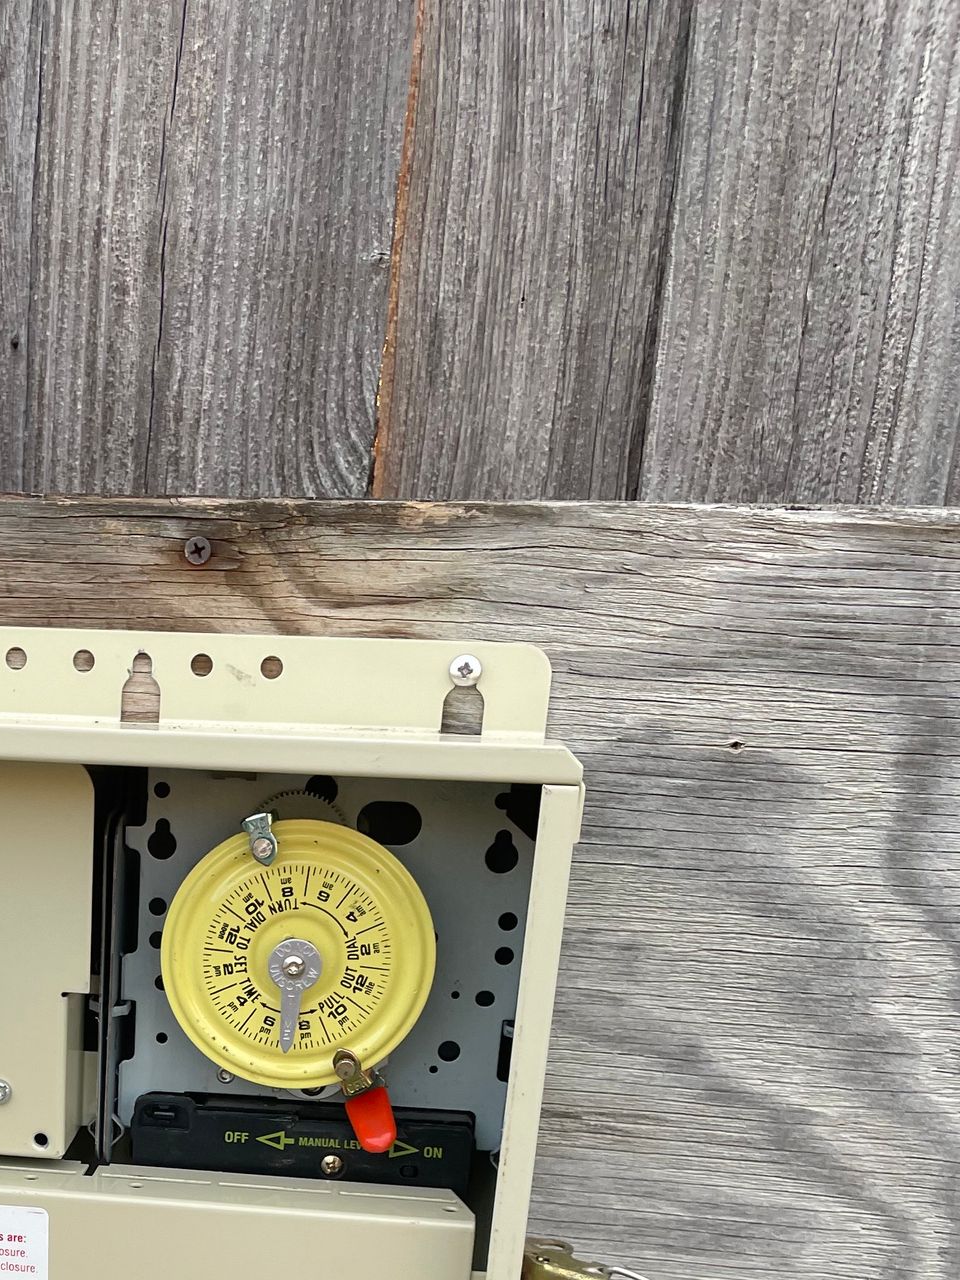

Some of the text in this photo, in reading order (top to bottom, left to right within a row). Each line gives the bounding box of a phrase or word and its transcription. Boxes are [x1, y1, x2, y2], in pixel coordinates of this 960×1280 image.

[243, 892, 253, 903] am
[281, 887, 294, 897] 8
[317, 891, 330, 902] 6
[245, 899, 265, 915] 10
[268, 898, 299, 917] TURN
[243, 912, 267, 933] DIAL
[346, 911, 357, 923] 4
[218, 923, 229, 939] noon
[225, 925, 240, 945] 12
[236, 937, 251, 950] TO
[373, 942, 379, 954] am
[360, 944, 371, 956] 2
[223, 963, 233, 975] 2
[234, 955, 247, 973] SET
[213, 965, 222, 977] pm
[319, 936, 359, 1014] PULL OUT DIAL
[239, 977, 260, 1002] TIME
[352, 975, 367, 994] 12
[364, 981, 375, 996] nite
[227, 1001, 239, 1013] pm
[236, 996, 247, 1007] 4
[328, 1003, 347, 1020] 10
[263, 1016, 276, 1027] 6
[299, 1020, 310, 1030] 8
[338, 1015, 350, 1026] pm
[260, 1026, 271, 1035] pm
[300, 1031, 312, 1040] pm
[224, 1131, 249, 1144] OFF
[298, 1136, 363, 1151] MANUAL LEV
[423, 1146, 442, 1159] ON
[6, 1234, 26, 1243] are:
